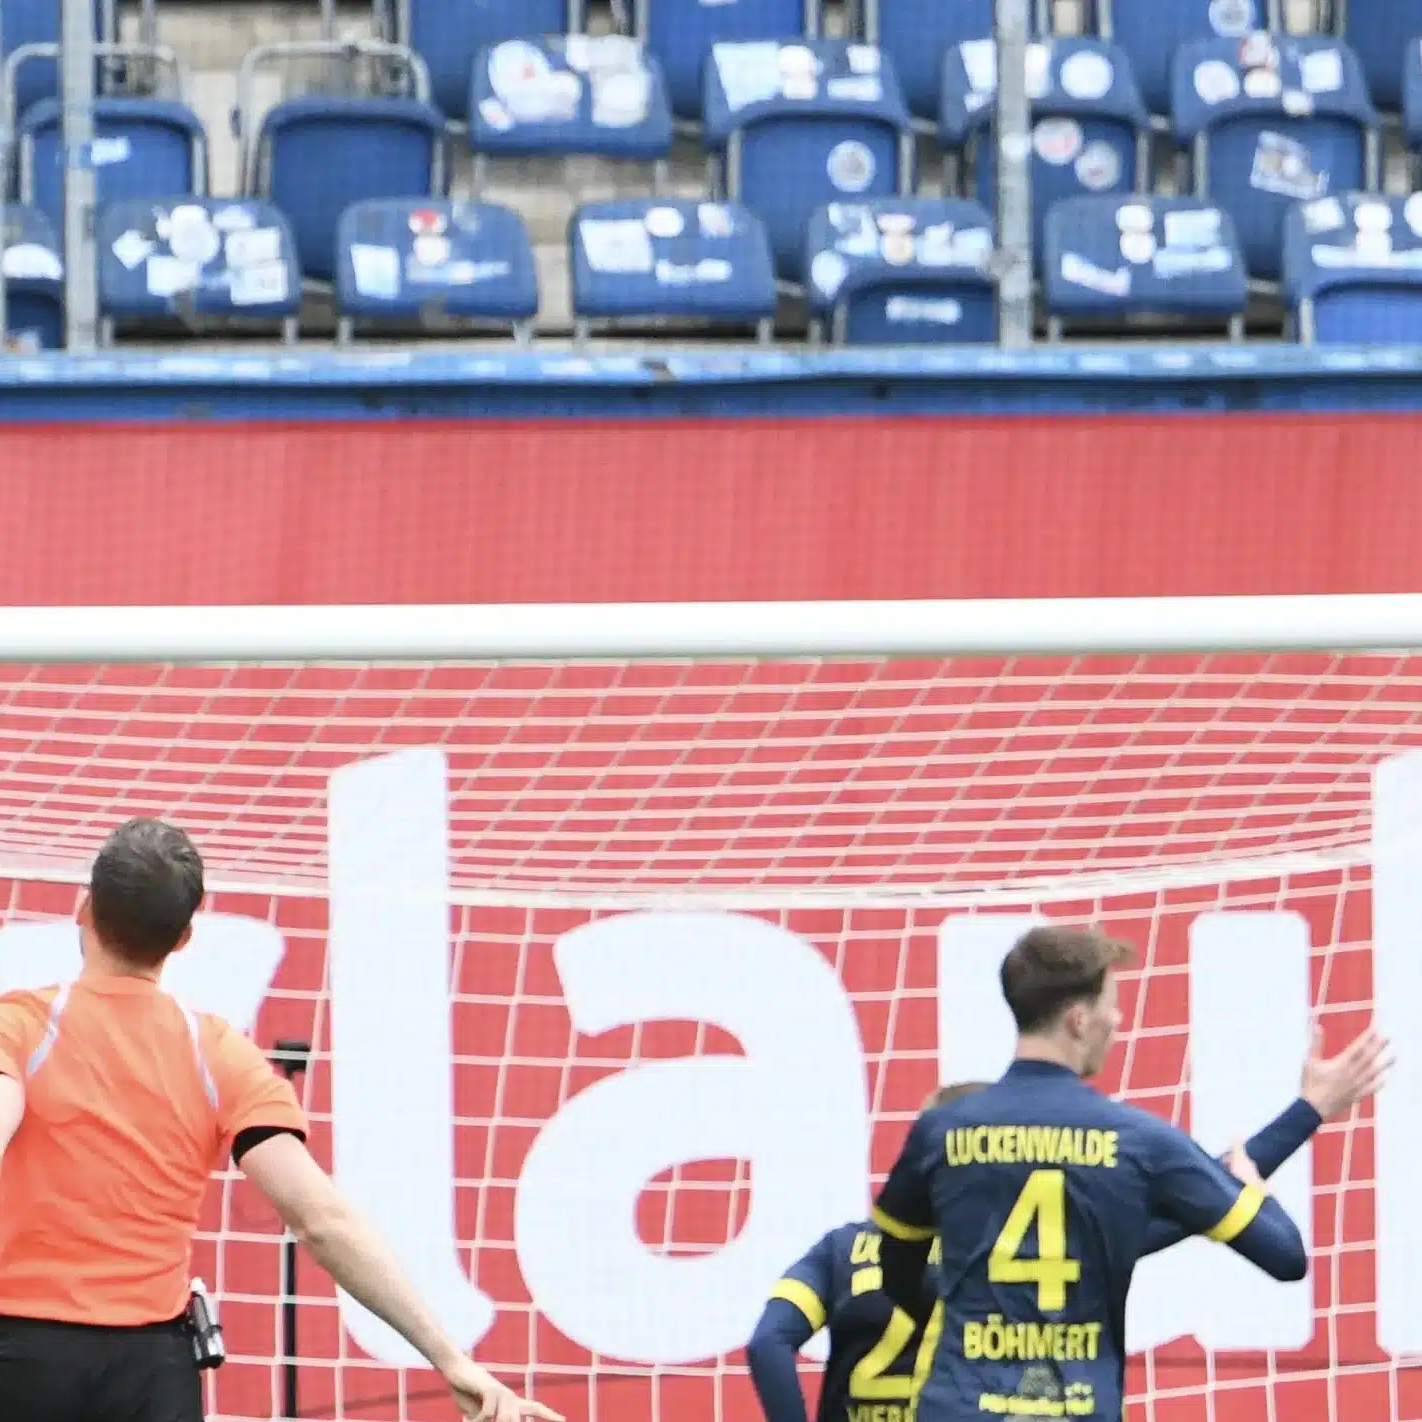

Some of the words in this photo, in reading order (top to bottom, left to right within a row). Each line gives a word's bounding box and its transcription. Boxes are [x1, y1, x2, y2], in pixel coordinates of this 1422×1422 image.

[945, 1126, 1119, 1168] LUCKENWALDE
[988, 1169, 1081, 1312] 4
[963, 1313, 1102, 1361] BÖHMERT
